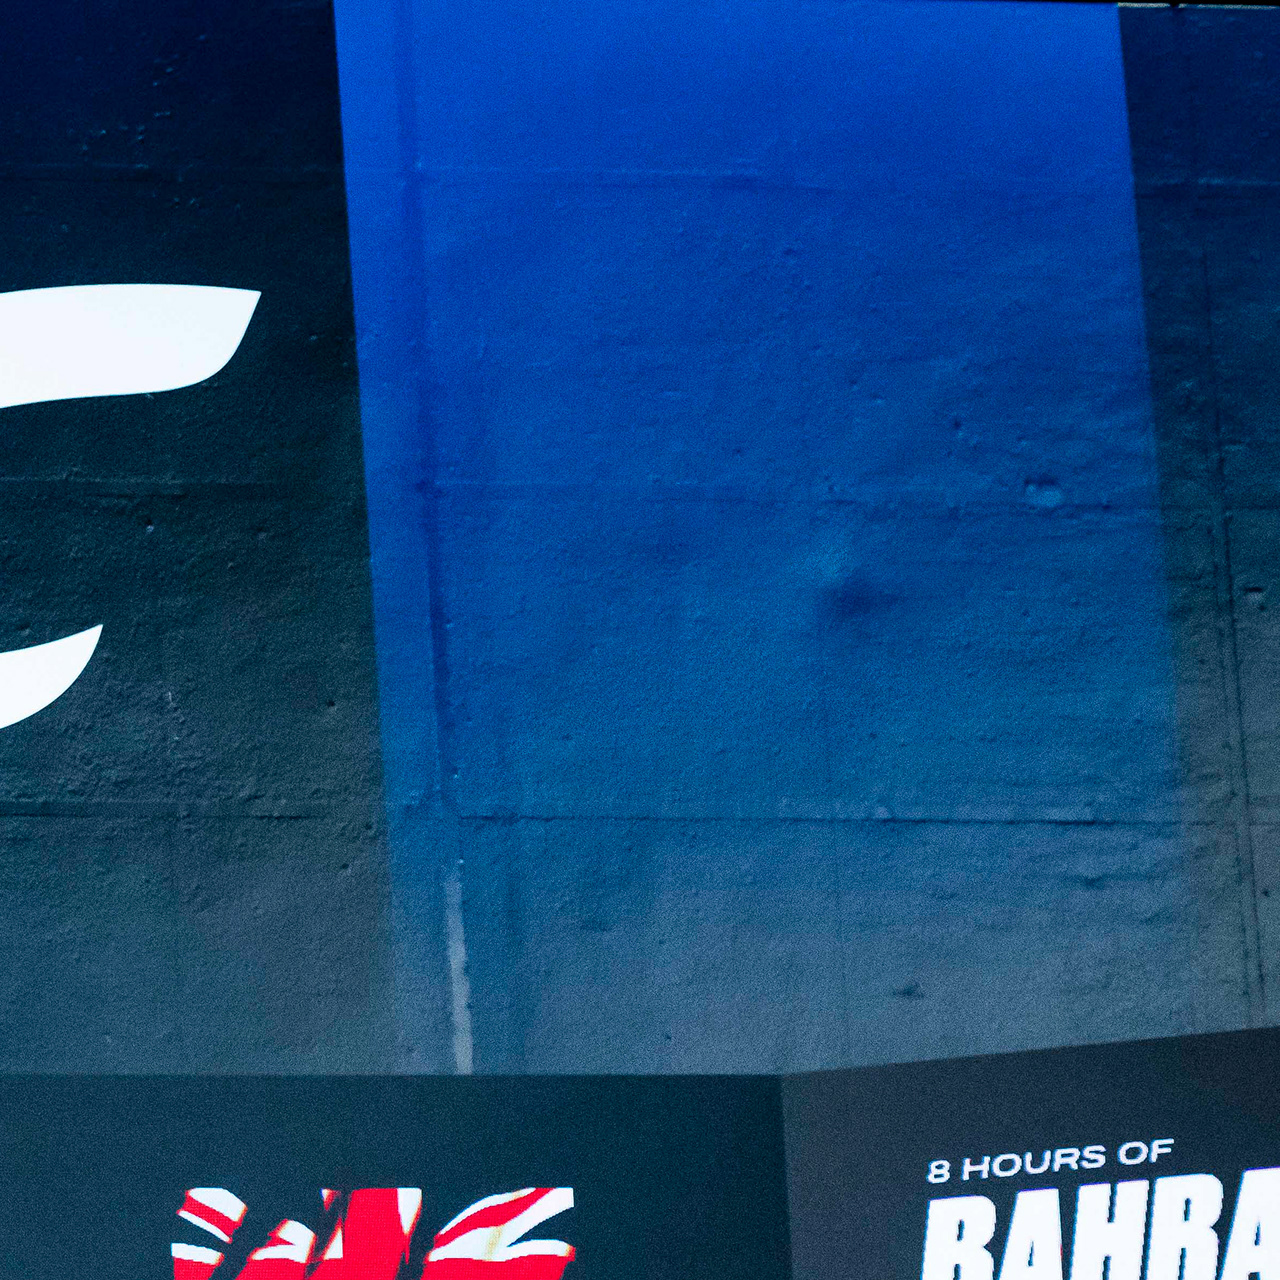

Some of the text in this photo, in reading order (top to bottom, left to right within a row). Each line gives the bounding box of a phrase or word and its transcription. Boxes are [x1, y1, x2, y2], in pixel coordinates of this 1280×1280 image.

[927, 1138, 1175, 1184] 8 HOURS OF
